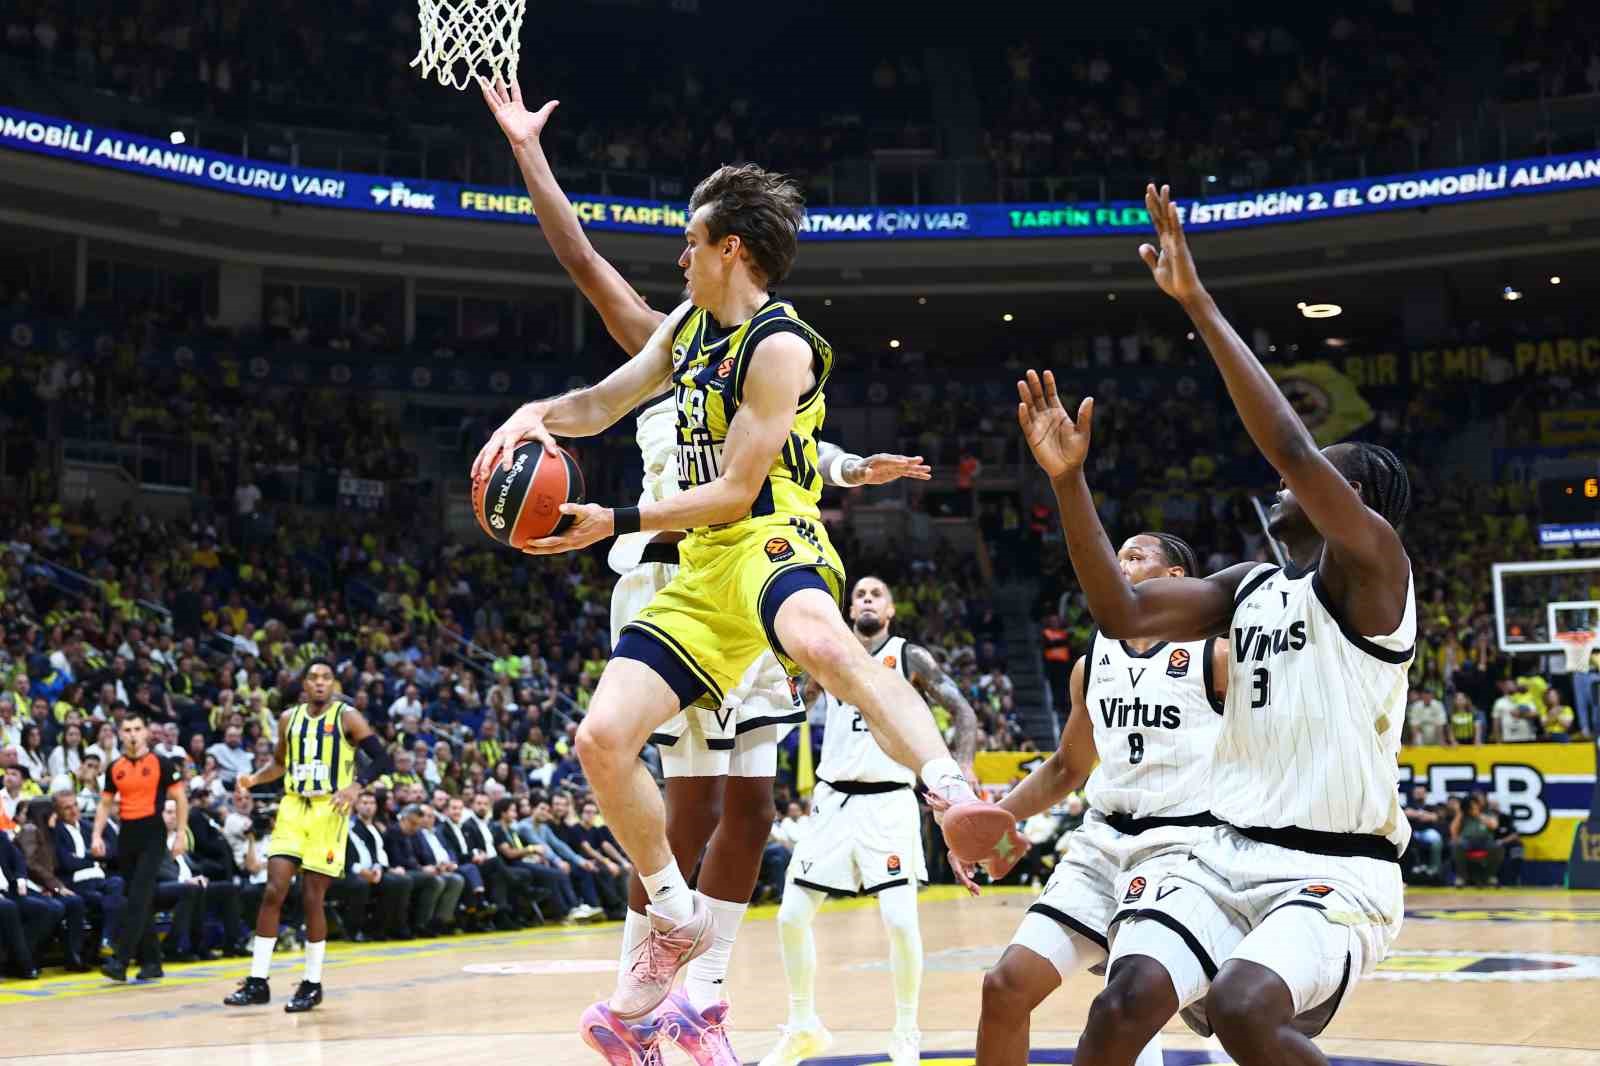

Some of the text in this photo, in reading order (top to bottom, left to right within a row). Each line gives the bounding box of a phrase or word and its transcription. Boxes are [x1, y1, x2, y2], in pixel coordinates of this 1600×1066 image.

[0, 116, 345, 199] MOBİLİ ALMANIN OLURU VAR!
[1010, 207, 1090, 227] TARFİN
[1307, 192, 1328, 211] 2.
[1333, 189, 1363, 208] EL
[1367, 166, 1507, 203] OTOMOBİLİ
[1099, 697, 1181, 729] Virtus
[1128, 732, 1144, 764] 8
